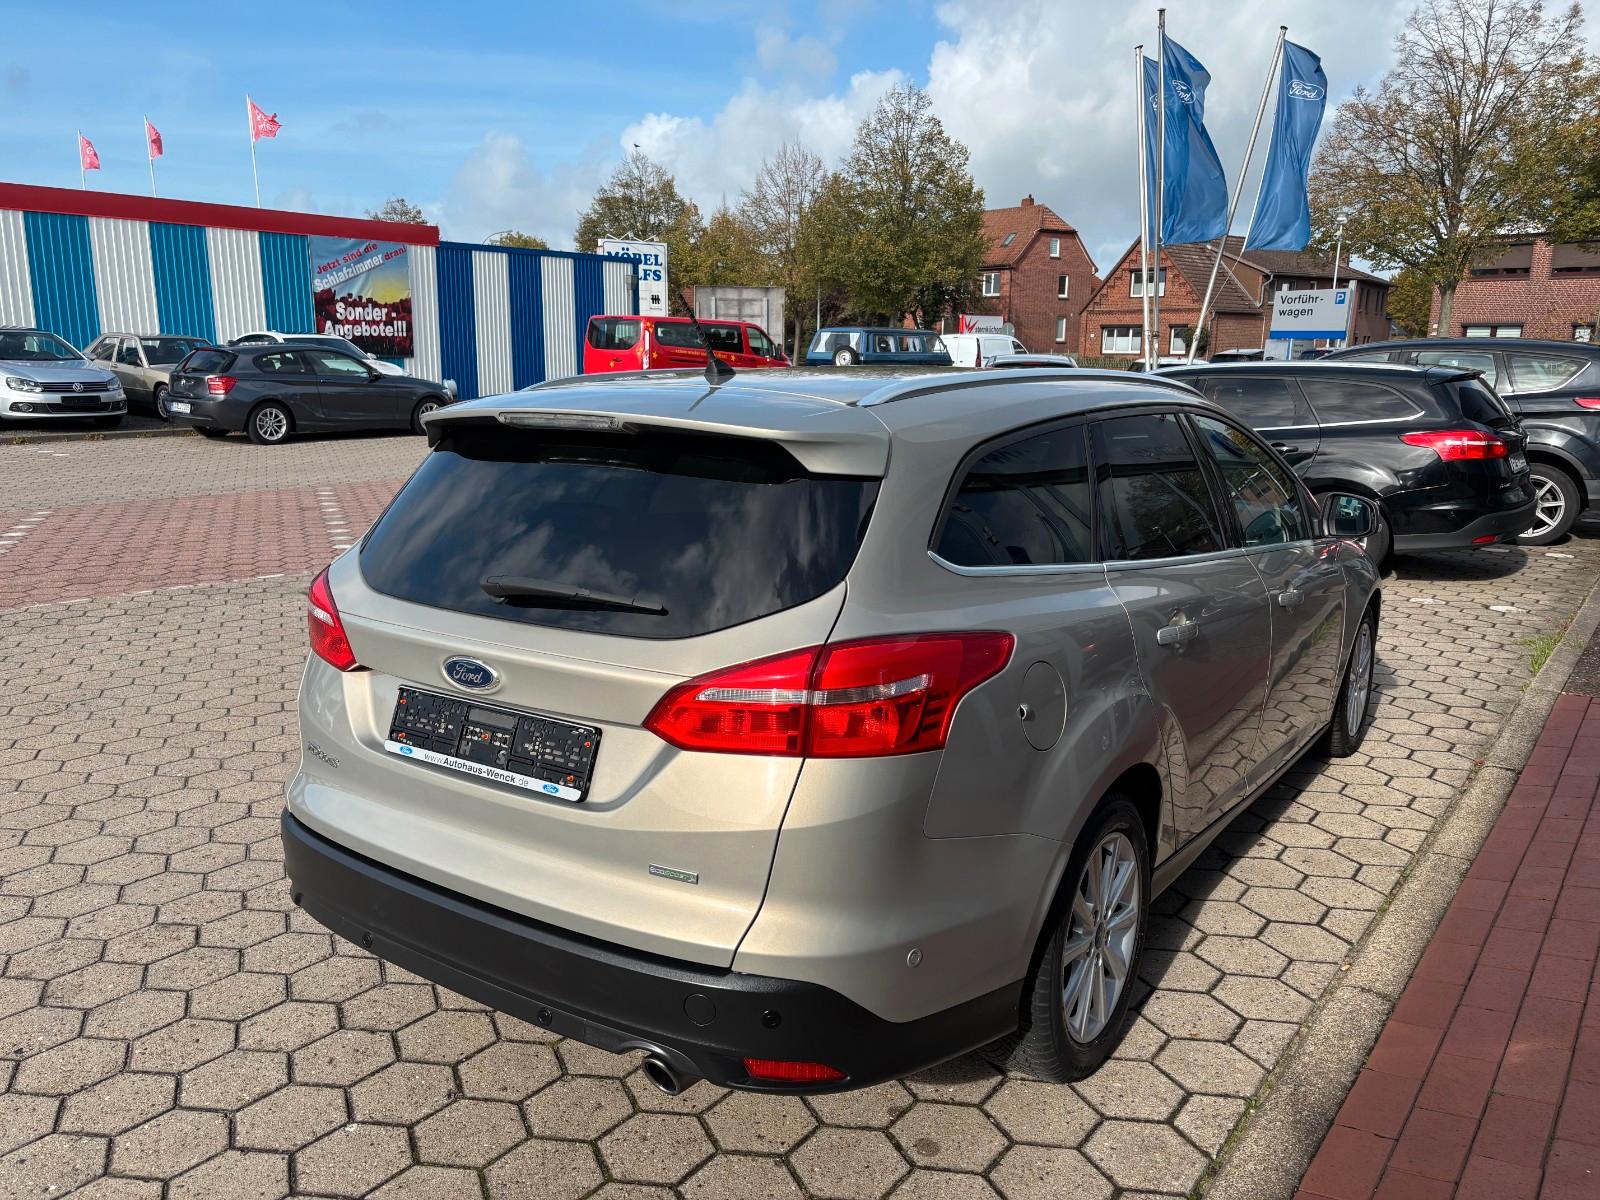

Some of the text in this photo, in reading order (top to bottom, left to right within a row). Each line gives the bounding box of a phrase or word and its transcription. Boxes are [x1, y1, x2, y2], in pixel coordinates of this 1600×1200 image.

[1290, 81, 1318, 98] Ford
[317, 242, 379, 275] Jetzt sind die
[313, 244, 408, 293] Schlafzimmer dran!
[1280, 294, 1324, 305] Vorführ-
[1278, 308, 1314, 319] wagen
[324, 320, 407, 339] Angebote!!!
[453, 662, 483, 683] Ford
